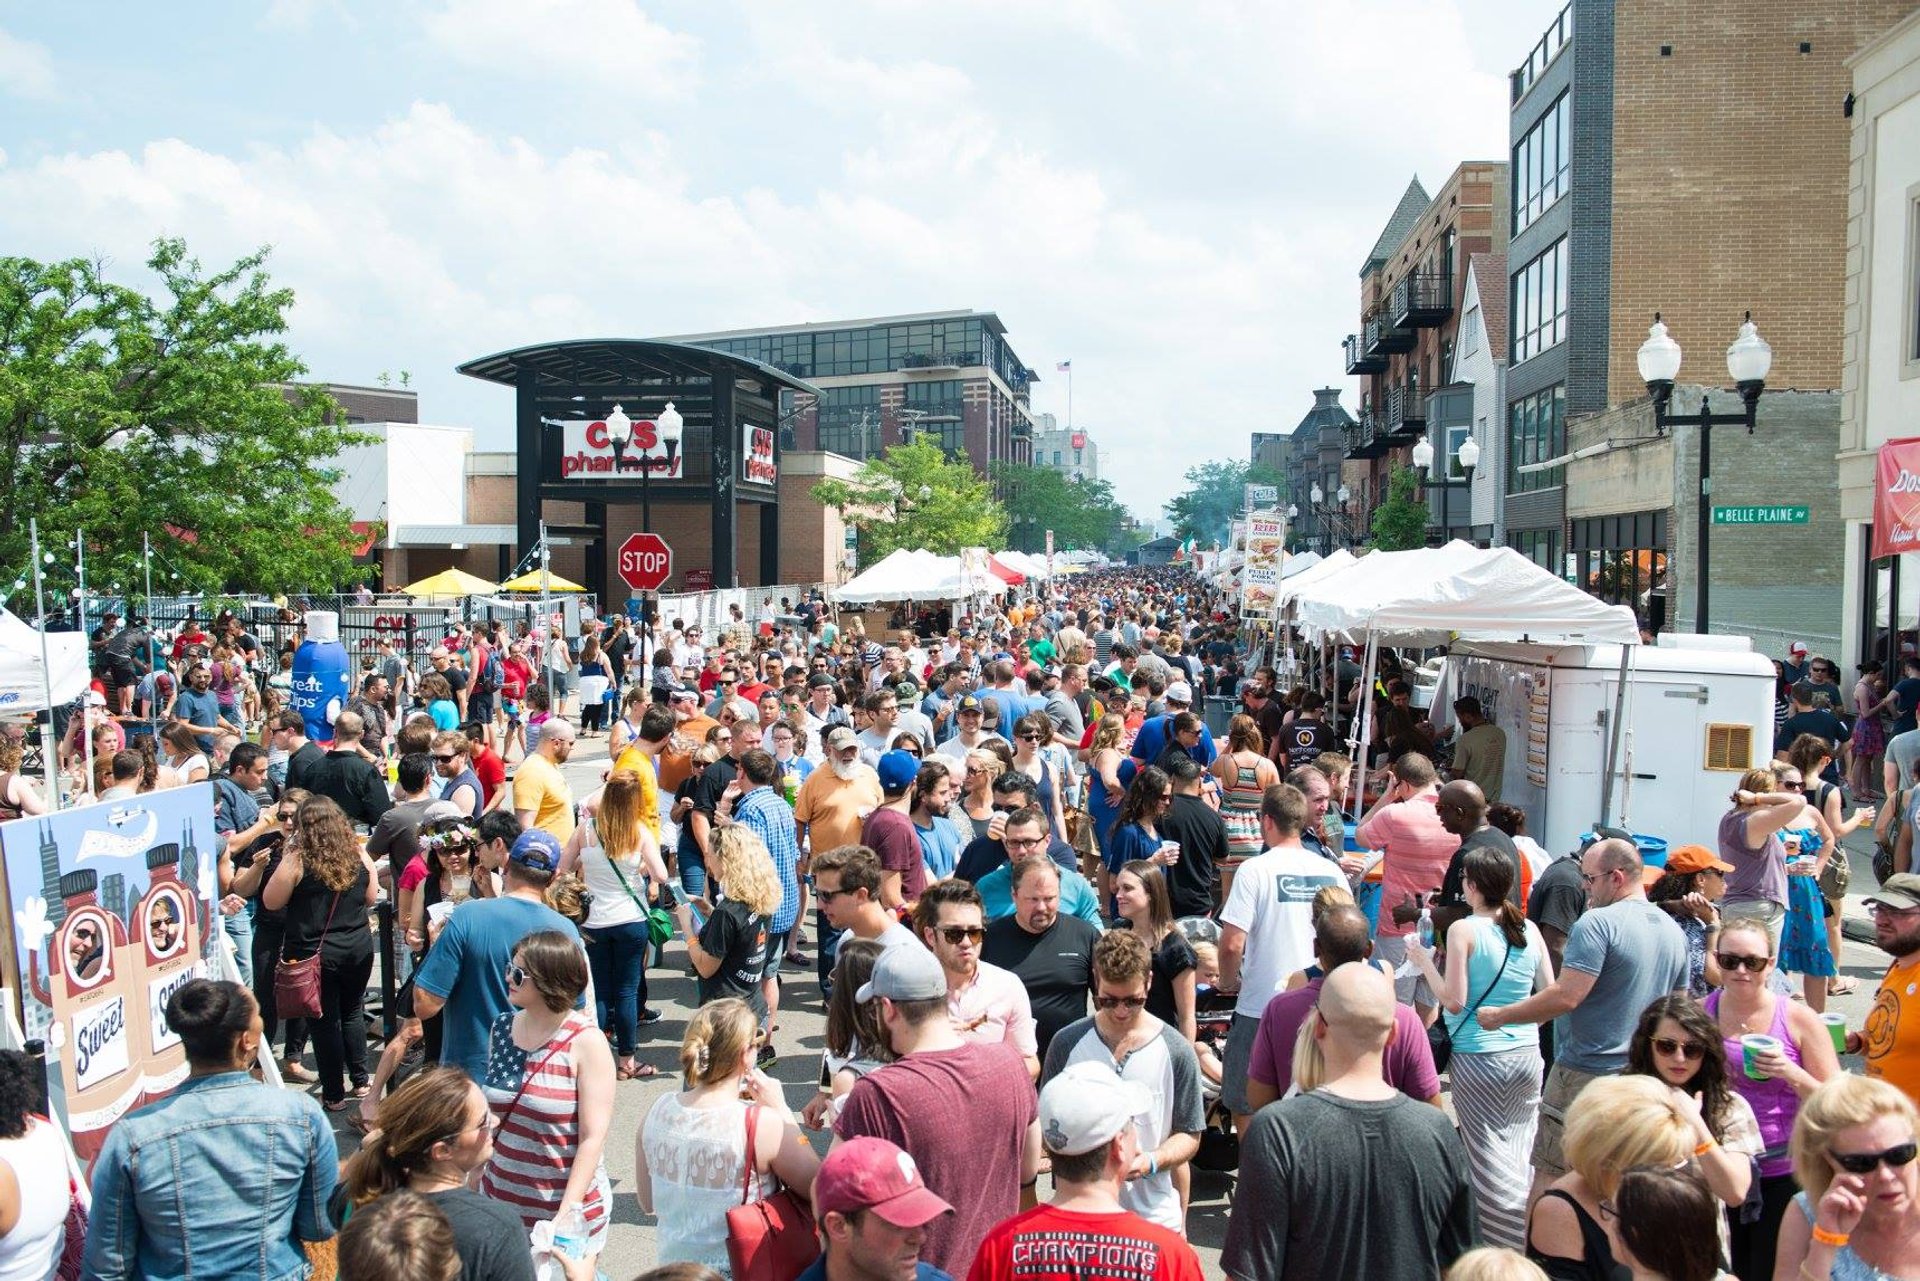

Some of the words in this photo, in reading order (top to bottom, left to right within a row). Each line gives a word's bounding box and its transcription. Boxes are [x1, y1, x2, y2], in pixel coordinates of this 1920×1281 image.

[586, 421, 657, 448] CS
[562, 451, 681, 476] pharmcy
[1726, 509, 1754, 521] BELLE
[1758, 508, 1793, 521] PLAINE
[622, 551, 667, 572] STOP
[290, 678, 323, 692] reat
[77, 997, 124, 1076] Sweet
[1013, 1240, 1157, 1272] CHAMPIONS
